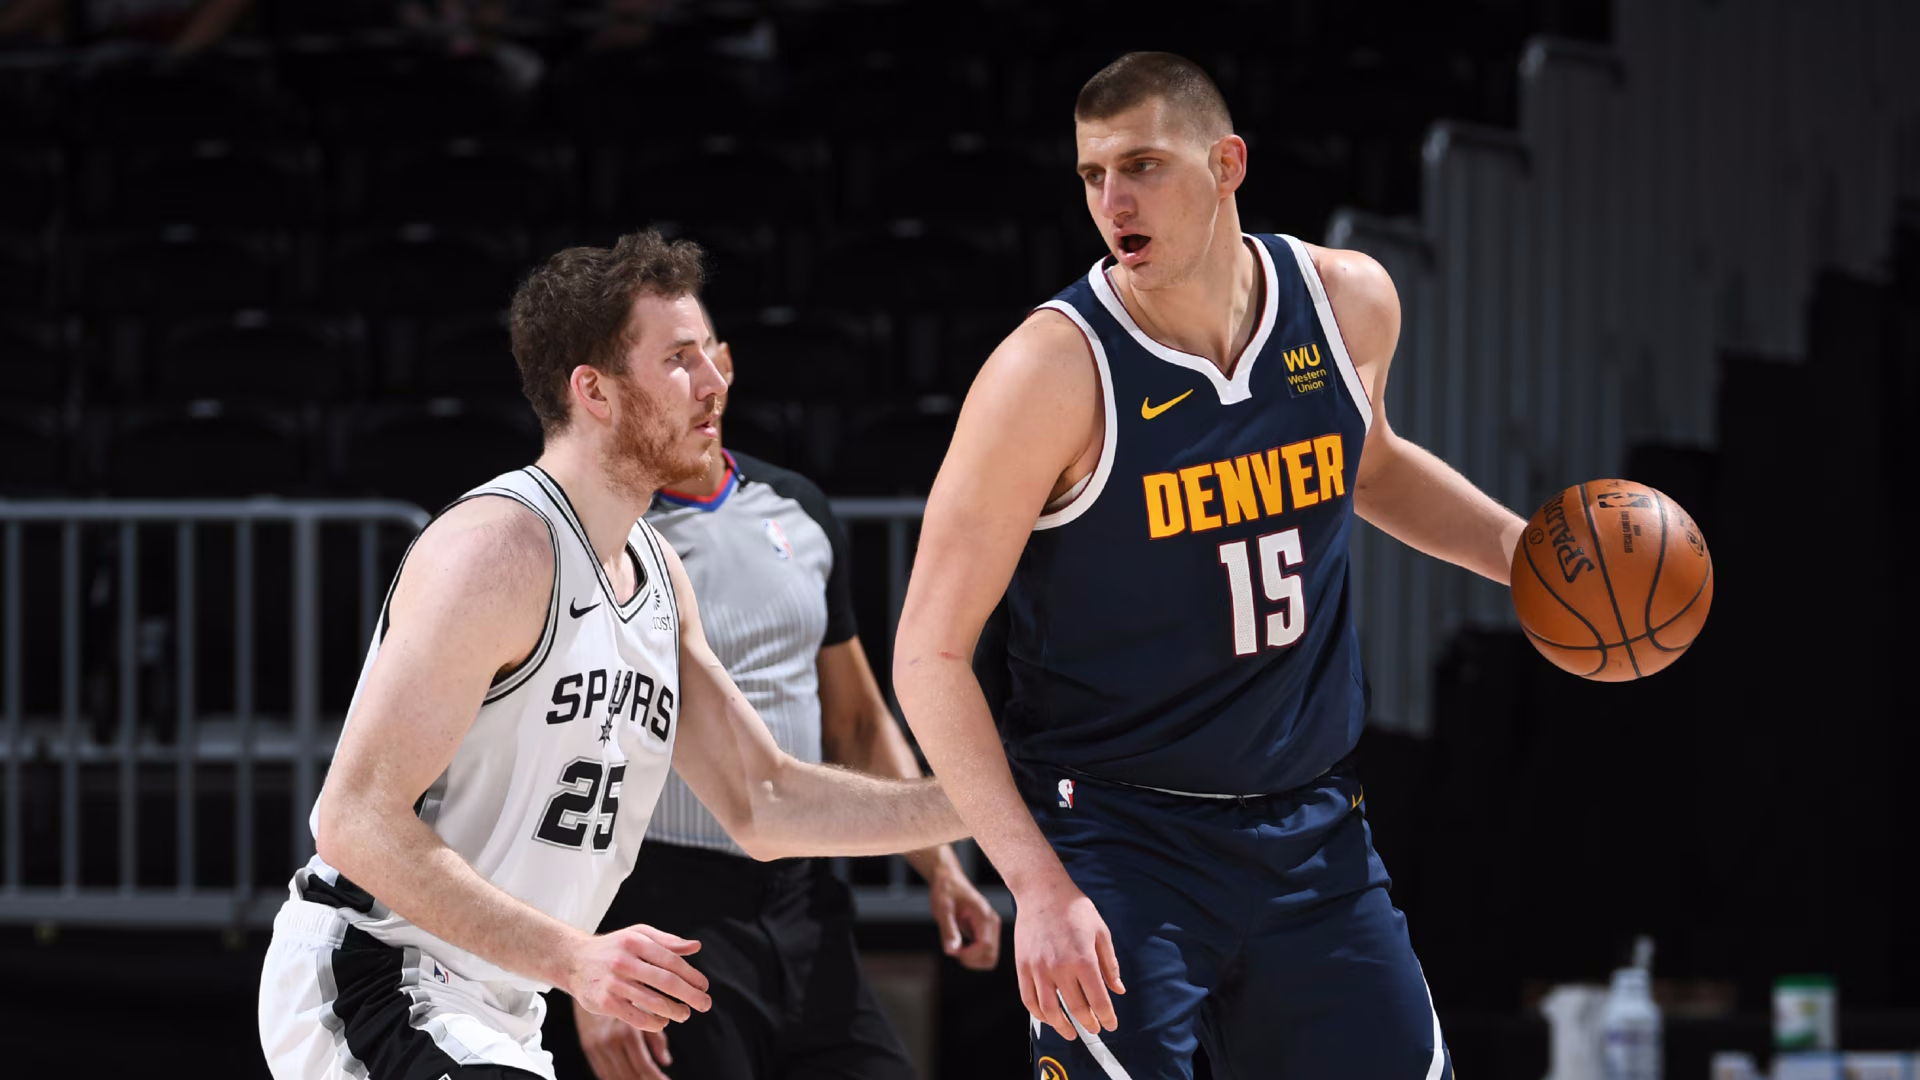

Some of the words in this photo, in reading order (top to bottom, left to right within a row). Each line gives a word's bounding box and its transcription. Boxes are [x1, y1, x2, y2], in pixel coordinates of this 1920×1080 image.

[1283, 344, 1320, 372] WU
[1288, 369, 1326, 385] Western
[1297, 381, 1324, 393] Union
[1142, 433, 1345, 539] DENVER
[1217, 527, 1306, 656] 15
[546, 669, 673, 742] SPURS
[531, 756, 629, 854] 25
